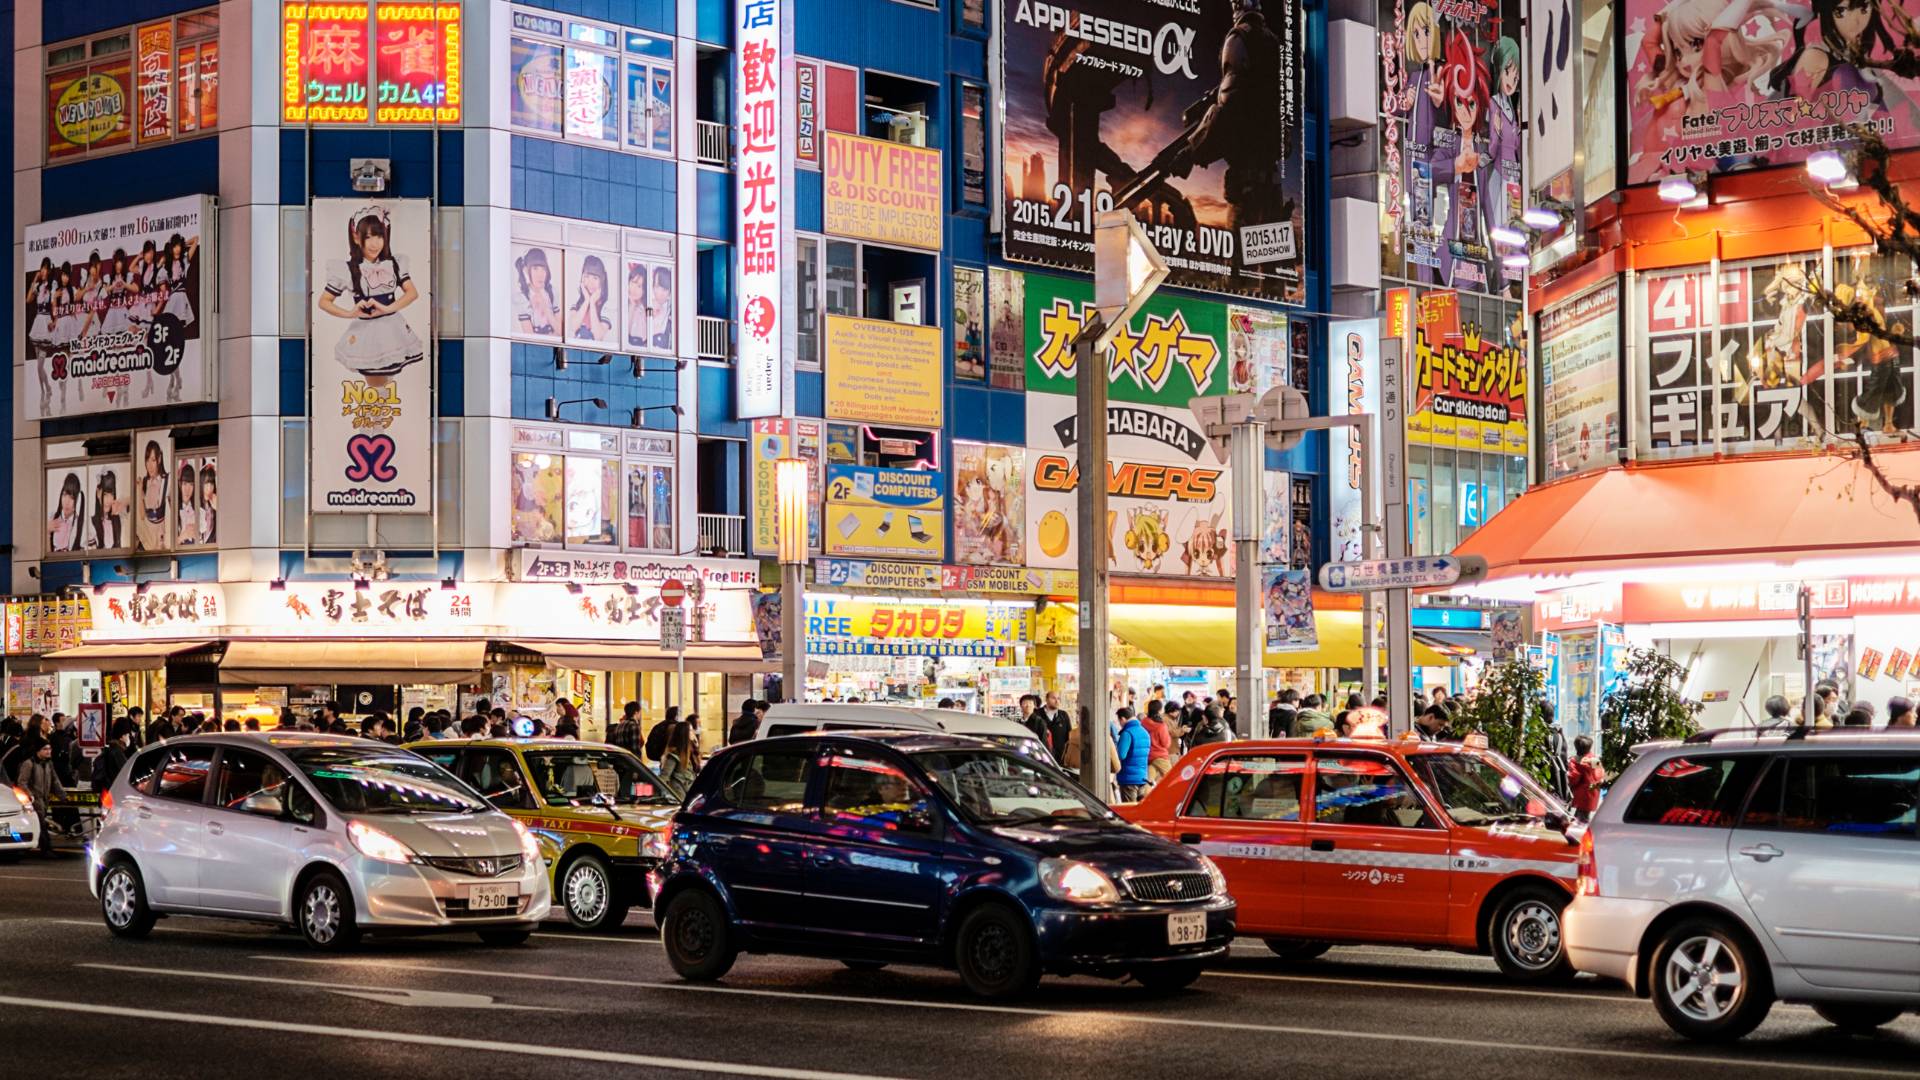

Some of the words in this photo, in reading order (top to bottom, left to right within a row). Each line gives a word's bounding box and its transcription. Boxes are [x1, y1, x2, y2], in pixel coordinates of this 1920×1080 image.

[1014, 0, 1152, 56] APPLESEED
[307, 25, 439, 77] 麻雀
[1075, 53, 1118, 71] アップルシード
[1119, 63, 1144, 78] アルファ
[59, 93, 121, 124] WELCOME
[801, 68, 814, 153] ウェルカム
[144, 127, 166, 137] AKIBA
[828, 138, 882, 186] DUTY
[889, 147, 939, 194] FREE
[828, 181, 842, 197] &
[847, 183, 939, 211] DISCOUNT
[828, 201, 857, 217] LIBRE
[862, 205, 876, 220] DE
[879, 208, 939, 231] IMPUESTOS
[1140, 218, 1184, 257] -ray
[1185, 233, 1197, 252] &
[1200, 226, 1235, 259] DVD
[1245, 227, 1290, 248] 2015.1.17
[1246, 245, 1291, 259] ROADSHOW
[1653, 272, 1741, 328] 4F
[154, 324, 169, 344] 3F
[853, 322, 897, 334] OVERSEAS
[72, 347, 151, 376] maidreamin
[165, 346, 180, 367] 2F
[1415, 327, 1527, 400] カードキングダム
[341, 380, 401, 405] No.1
[1384, 358, 1396, 421] 中央通り
[341, 405, 401, 416] メイドカフェ
[1434, 397, 1508, 421] Cardkingdom
[352, 416, 394, 430] グループ
[760, 421, 784, 433] 2F
[1073, 411, 1190, 452] HABARA
[879, 471, 932, 486] DISCOUNT
[328, 489, 415, 505] maidreamin
[833, 482, 850, 500] 2F
[874, 484, 937, 499] COMPUTERS
[759, 462, 769, 545] COMPUTERS
[574, 559, 611, 571] No.1メイド
[631, 563, 700, 581] maidreamin
[831, 563, 847, 582] 2F
[871, 563, 921, 575] DISCOUNT
[974, 568, 1021, 580] DISCOUNT
[574, 571, 610, 580] カフェグループ
[702, 567, 730, 584] Free
[731, 571, 757, 584] WiFi
[865, 575, 926, 587] COMPUTERS
[943, 568, 957, 587] 2F
[966, 579, 986, 591] GSM
[989, 580, 1029, 592] MOBILES
[24, 602, 85, 618] インターネット
[129, 588, 200, 624] 富士そば
[203, 595, 216, 608] 24
[321, 588, 432, 622] 富士そば
[451, 595, 471, 607] 24
[605, 593, 662, 624] 富士そ
[450, 607, 472, 617] 時間
[803, 616, 851, 637] REE
[543, 819, 573, 830] TAXI
[478, 894, 505, 907] 79-00
[1177, 925, 1205, 941] 98-73
